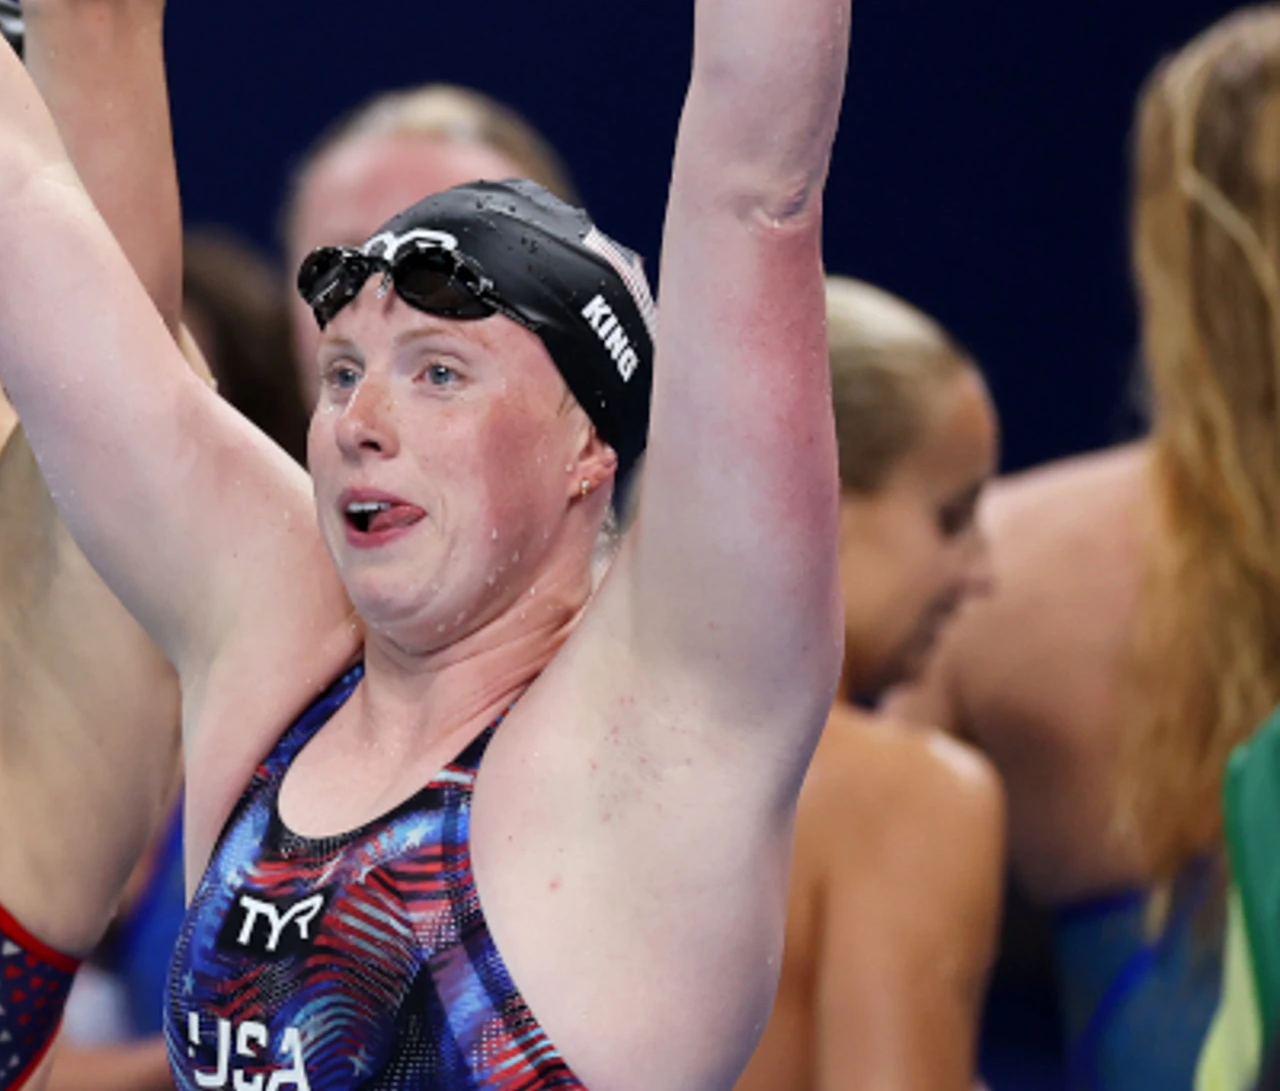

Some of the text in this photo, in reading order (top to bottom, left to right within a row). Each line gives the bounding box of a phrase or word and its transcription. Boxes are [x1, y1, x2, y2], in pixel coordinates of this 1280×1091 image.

[581, 294, 639, 383] KING
[237, 894, 324, 952] TYR
[188, 1011, 312, 1091] USA
